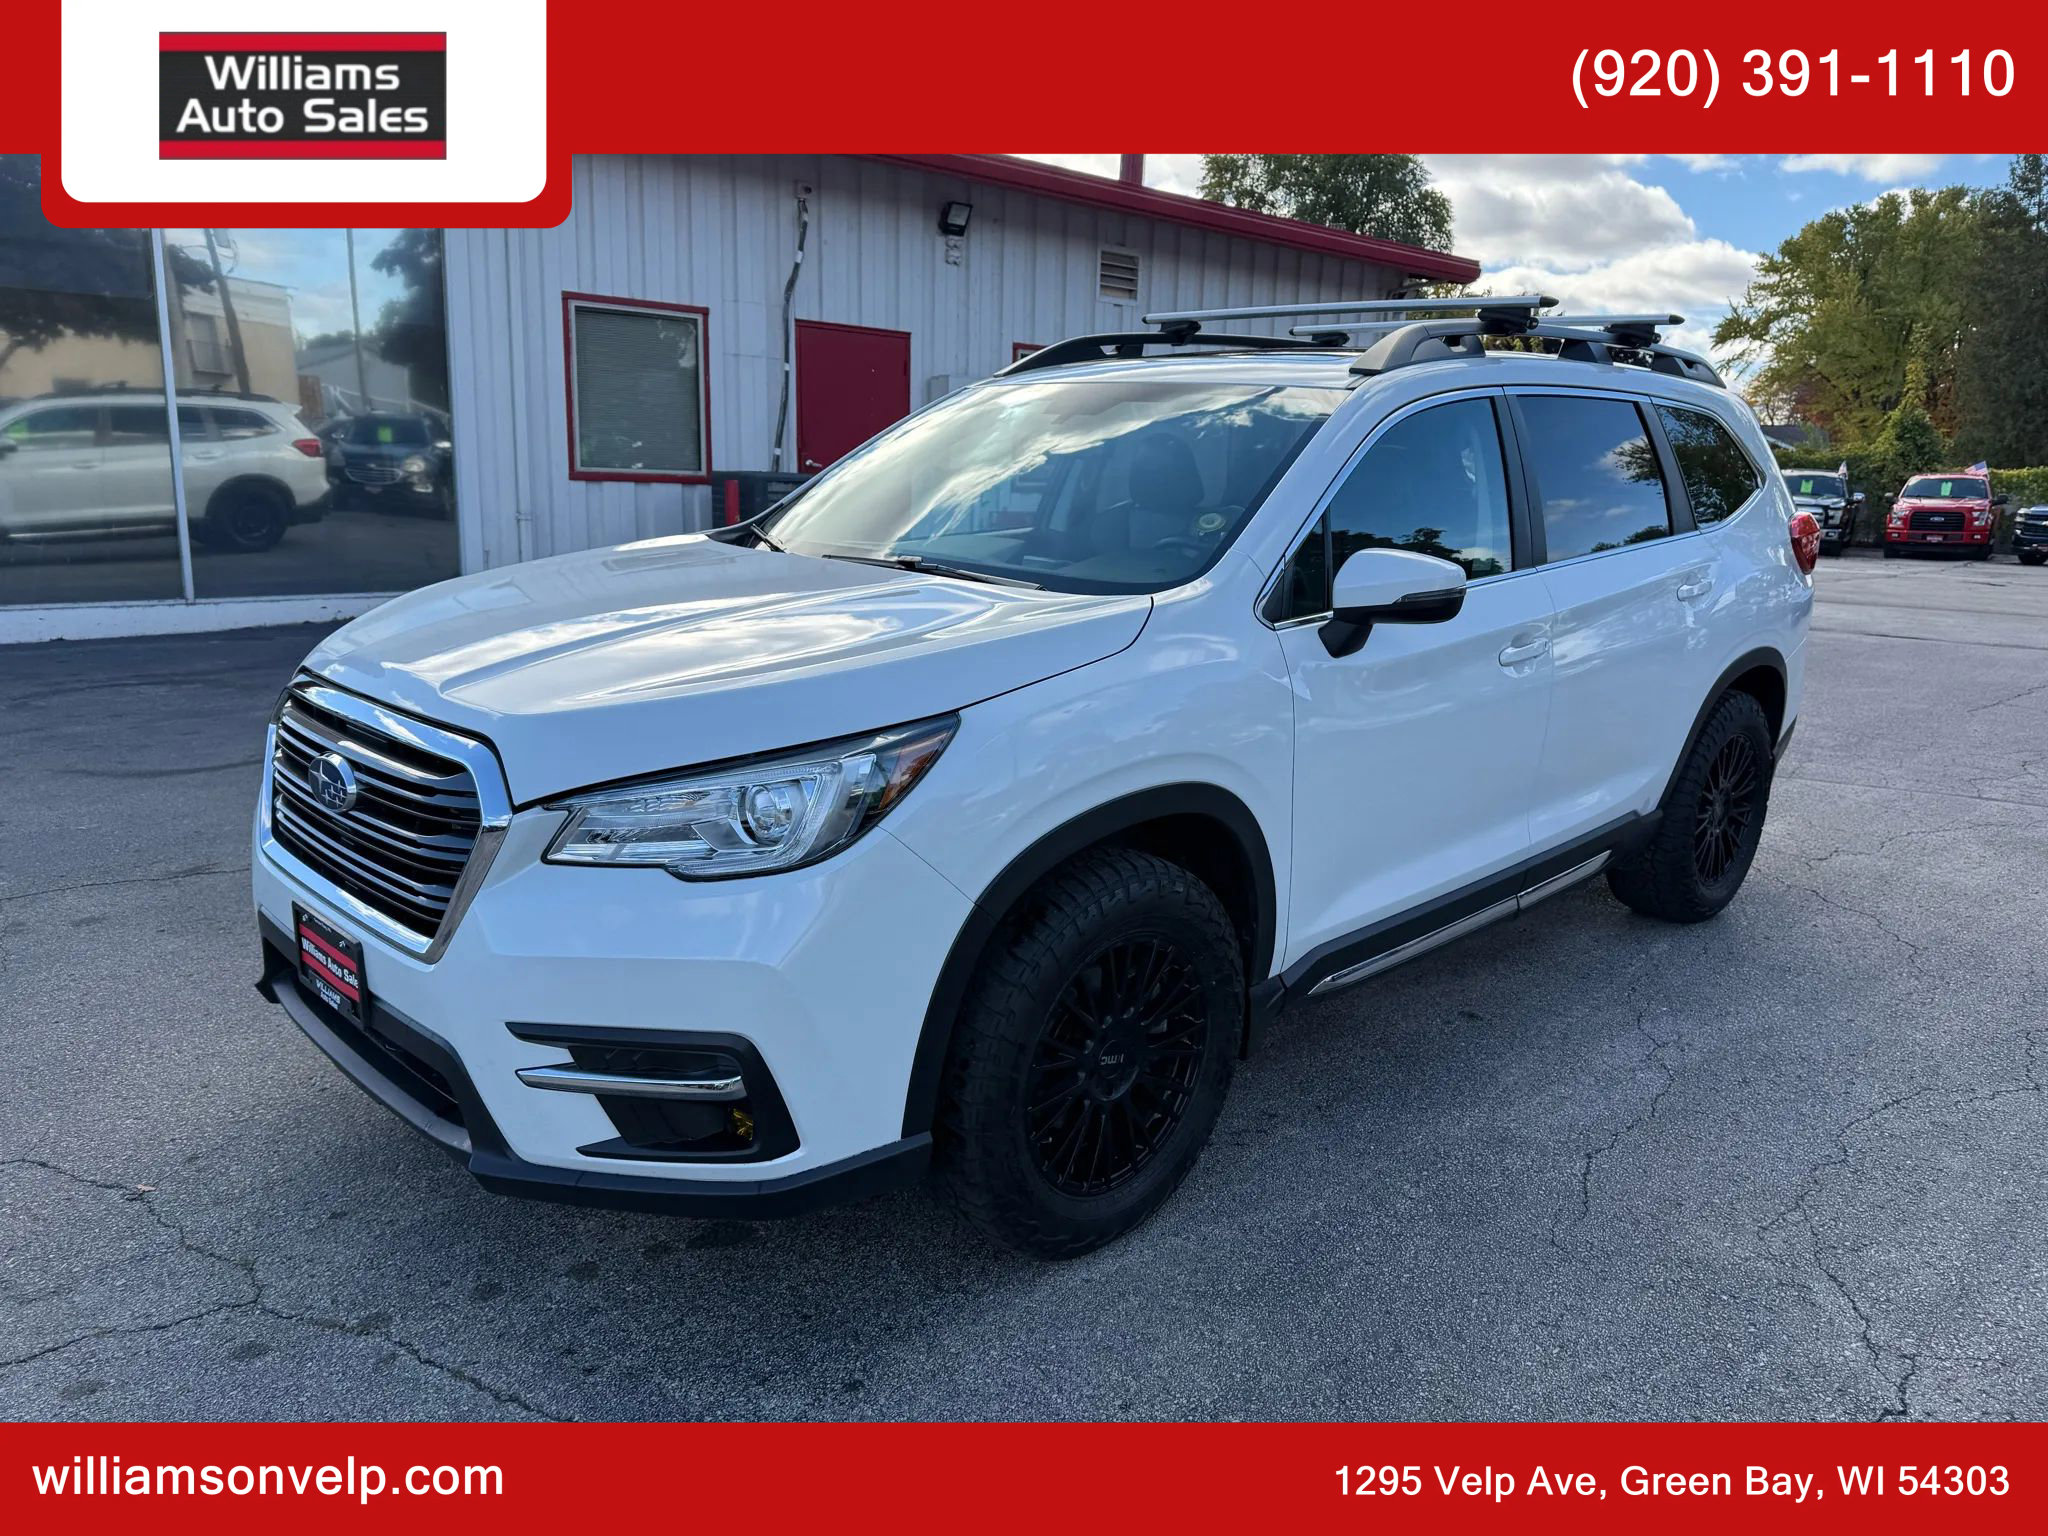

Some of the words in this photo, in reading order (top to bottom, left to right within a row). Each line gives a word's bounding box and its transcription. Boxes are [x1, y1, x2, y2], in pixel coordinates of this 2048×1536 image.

[301, 936, 327, 966] Williams
[327, 957, 342, 978] Auto
[343, 968, 359, 989] Sale
